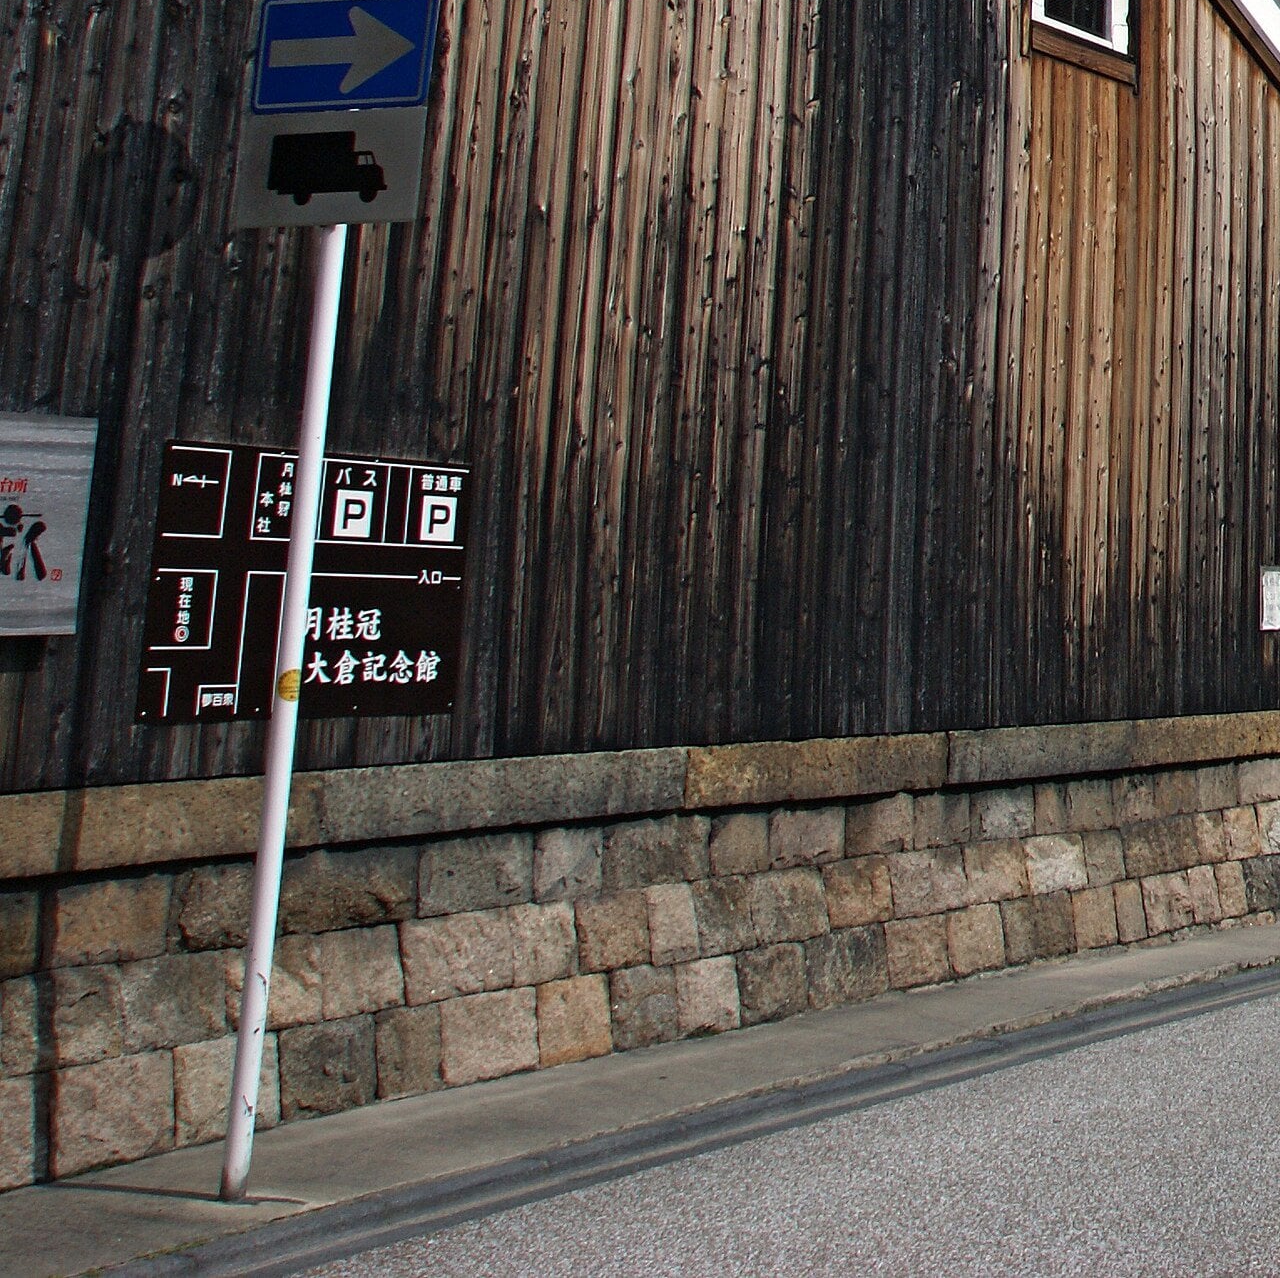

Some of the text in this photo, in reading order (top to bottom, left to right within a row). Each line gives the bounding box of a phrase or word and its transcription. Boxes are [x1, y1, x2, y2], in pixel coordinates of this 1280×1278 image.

[171, 473, 183, 486] N
[335, 467, 377, 487] バス
[421, 474, 463, 492] 普通車
[257, 491, 275, 533] 本社
[417, 569, 443, 585] 入口
[176, 577, 194, 625] 現在地
[304, 606, 382, 641] 月桂冠
[304, 650, 442, 685] 大倉記念館
